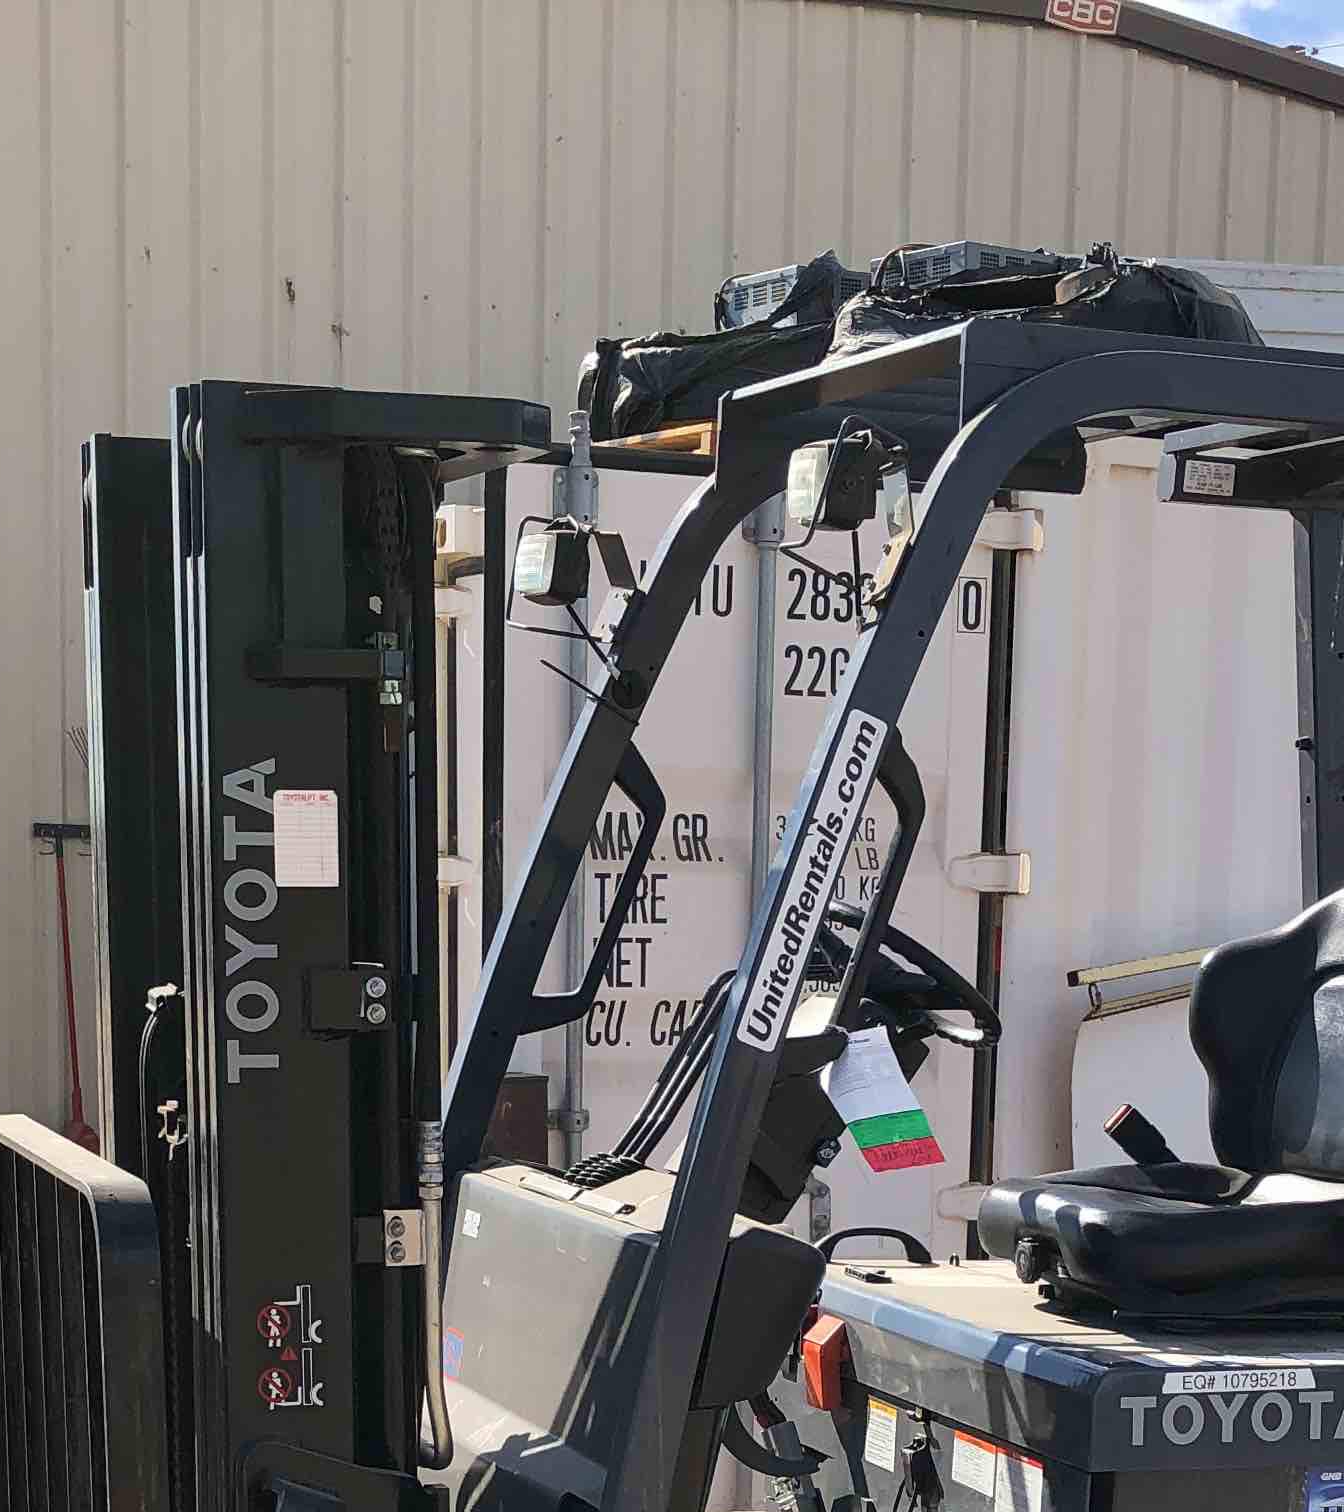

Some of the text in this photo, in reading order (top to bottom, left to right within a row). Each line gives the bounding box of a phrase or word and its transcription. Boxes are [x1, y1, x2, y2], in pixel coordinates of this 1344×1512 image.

[1052, 0, 1116, 26] CBC
[962, 580, 982, 630] 0
[747, 720, 877, 1042] UnitedRentals.com
[223, 757, 280, 1083] TOYOTA
[1182, 1372, 1297, 1391] EQ# 10795218
